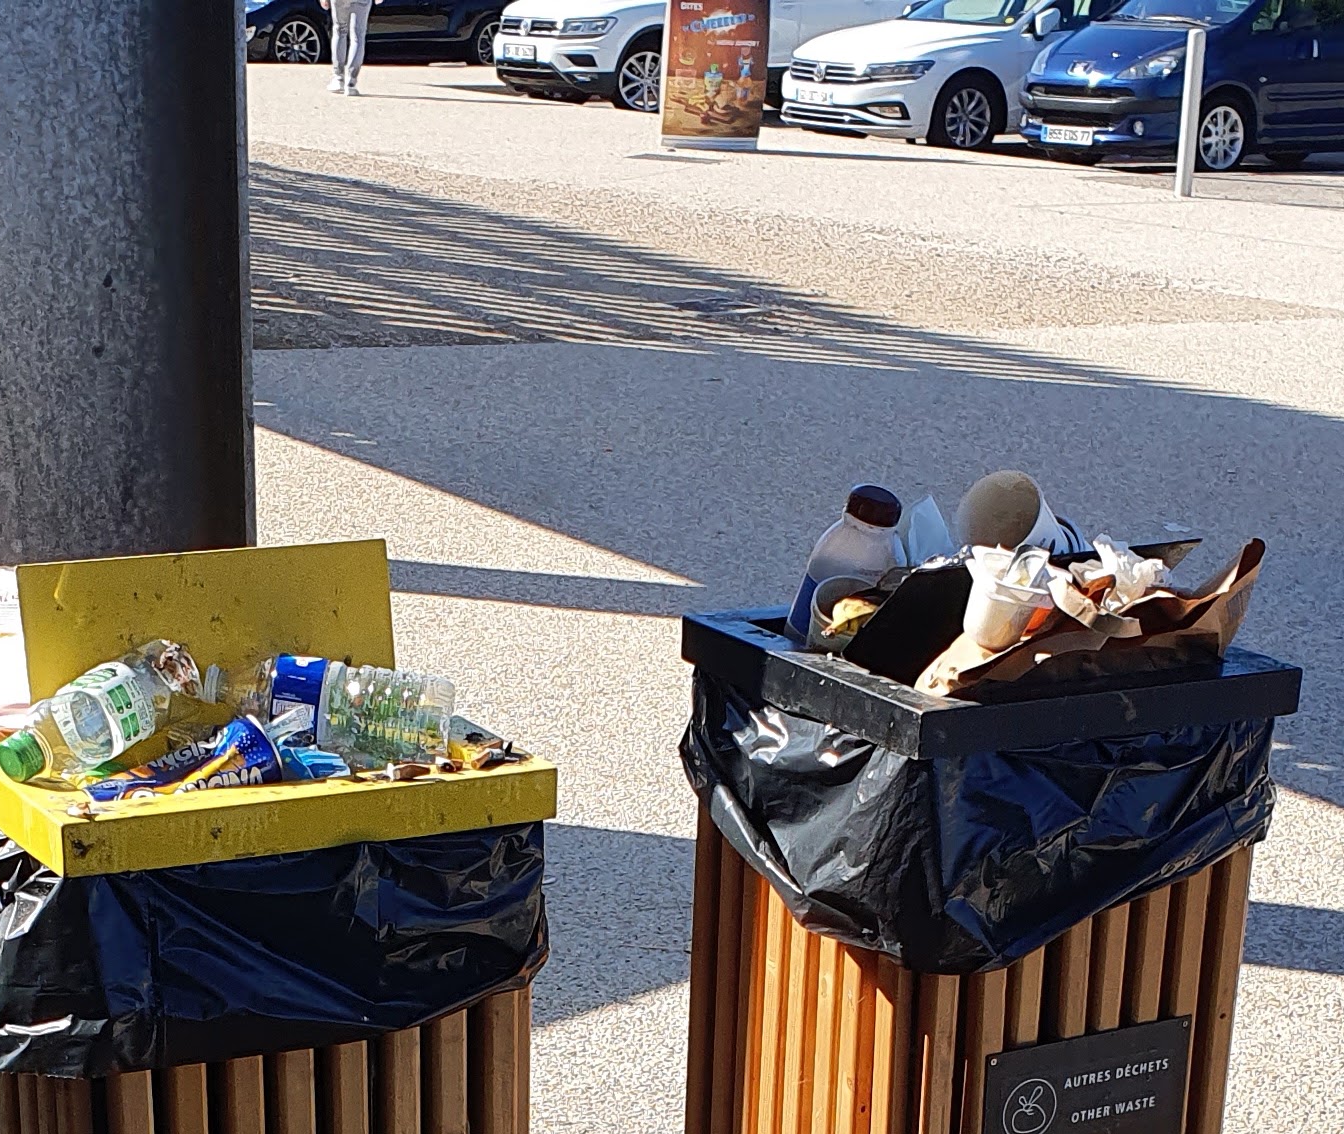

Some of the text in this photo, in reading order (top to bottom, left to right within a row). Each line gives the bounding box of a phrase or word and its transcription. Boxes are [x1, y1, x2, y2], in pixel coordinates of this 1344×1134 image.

[1080, 131, 1091, 142] 77
[1064, 1058, 1169, 1089] AUTRES DÉCHETS
[1071, 1096, 1156, 1124] OTHER WASTE
